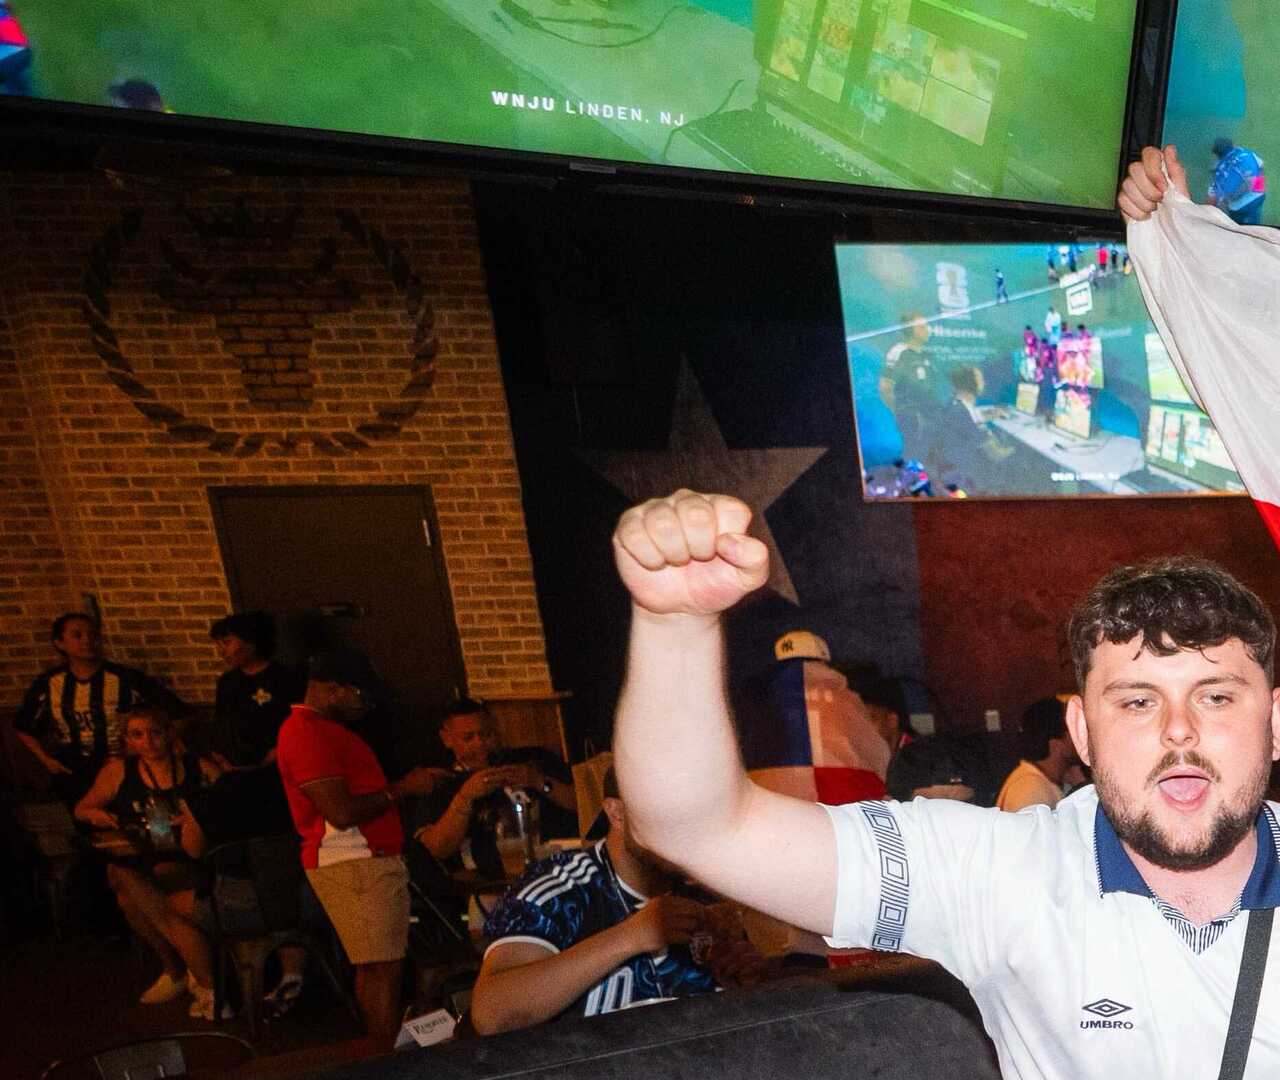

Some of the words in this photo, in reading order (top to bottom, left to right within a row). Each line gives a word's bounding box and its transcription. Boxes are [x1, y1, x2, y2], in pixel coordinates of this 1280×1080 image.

[491, 90, 555, 112] WNJU
[659, 110, 686, 127] NJ
[1079, 1019, 1134, 1030] UMBRO
